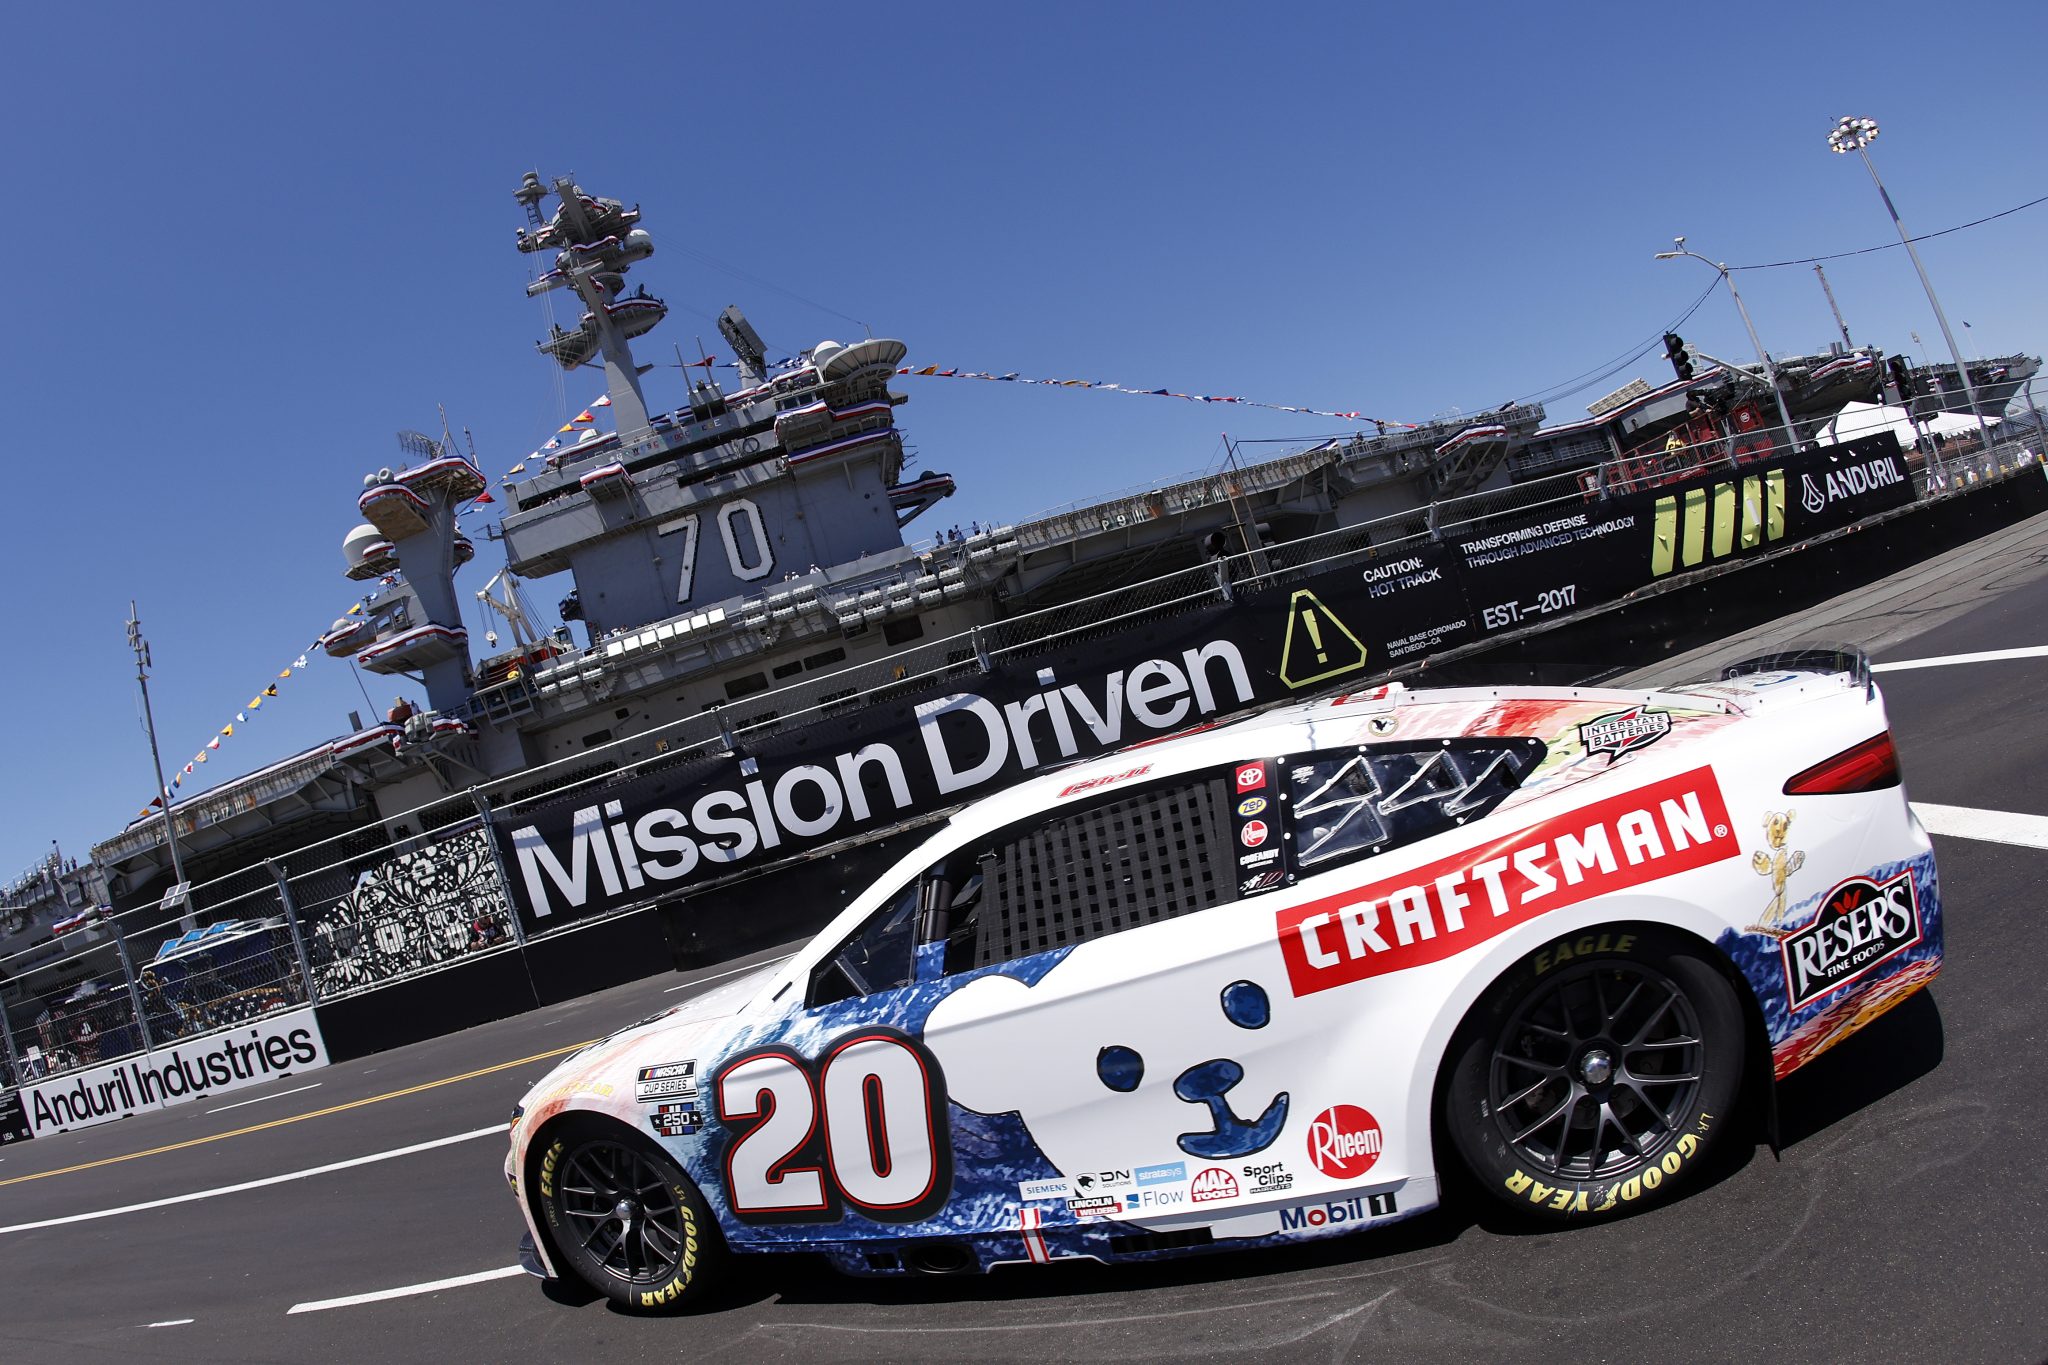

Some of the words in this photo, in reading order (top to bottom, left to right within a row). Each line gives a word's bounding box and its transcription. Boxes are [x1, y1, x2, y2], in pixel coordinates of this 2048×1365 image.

[1825, 457, 1904, 502] ANDURIL
[1460, 526, 1544, 555] TRANSFORMING
[1544, 514, 1588, 535] DEFENSE
[1465, 549, 1520, 569] THROUGH
[1520, 533, 1573, 556] ADVANCED
[1574, 516, 1635, 541] TECHNOLOGY
[657, 499, 776, 604] 70
[1363, 557, 1424, 583] CAUTION:
[1369, 580, 1395, 598] HOT
[1398, 567, 1442, 590] TRACK
[1387, 636, 1408, 650] NAVAL
[1409, 631, 1428, 645] BASE
[1428, 620, 1467, 639] CORONADO
[1389, 646, 1404, 658] SAN
[1586, 714, 1664, 736] INTERSTATE
[1594, 722, 1664, 747] BATTERIES
[511, 742, 913, 918] Mission
[914, 640, 1255, 795] Driven
[1300, 791, 1712, 970] CRAFTSMAN
[1535, 934, 1637, 976] EAGLE
[1793, 885, 1911, 997] RESER'S
[1827, 960, 1851, 978] FINE
[1852, 940, 1885, 965] FOODS
[34, 1066, 133, 1131] Anduril
[132, 1029, 317, 1105] Industries
[655, 1064, 688, 1078] NASCAR
[644, 1083, 659, 1093] CUP
[660, 1080, 687, 1092] SERIES
[663, 1112, 690, 1127] 250
[718, 1035, 938, 1214] 20
[1312, 1107, 1381, 1170] Rheem
[541, 1140, 564, 1198] EAGLE
[1099, 1169, 1130, 1182] DN
[1138, 1167, 1183, 1180] stratasys
[1243, 1161, 1284, 1178] Sport
[1258, 1173, 1294, 1186] Clips
[1504, 1133, 1698, 1212] GOODYEAR
[1026, 1183, 1068, 1194] SIEMENS
[1102, 1180, 1132, 1189] SOLUTIONS
[1143, 1190, 1184, 1207] Flow
[1193, 1188, 1237, 1200] TOOLS
[1250, 1183, 1292, 1194] HAIRCUTS
[1068, 1197, 1113, 1209] LINCOLN
[1080, 1207, 1118, 1216] WELDERS
[1279, 1197, 1363, 1230] Mobil
[641, 1205, 698, 1307] GOODYEAR
